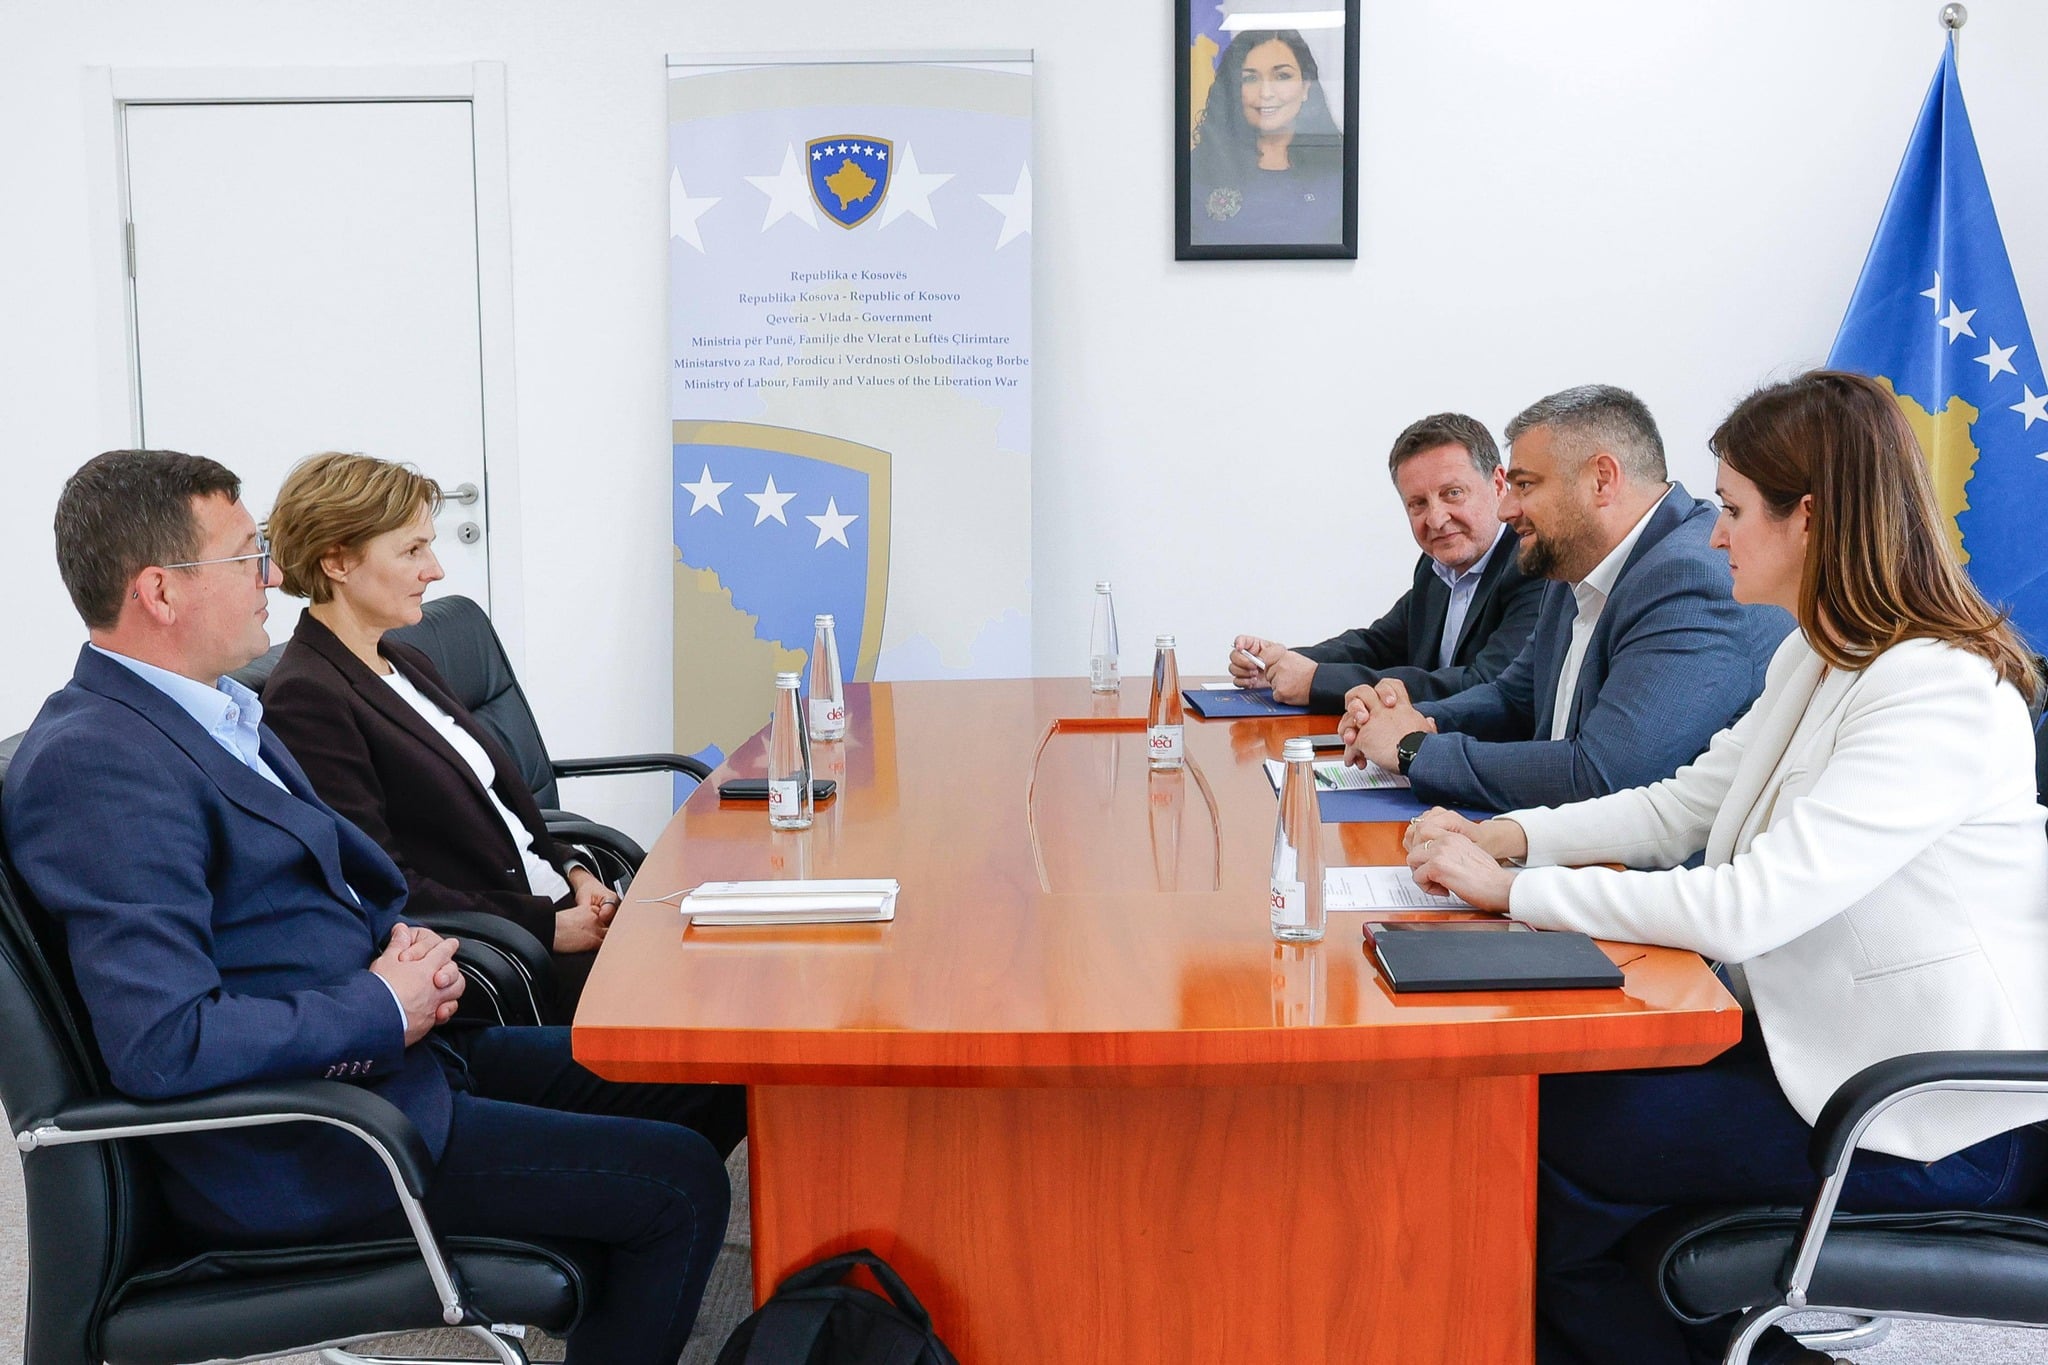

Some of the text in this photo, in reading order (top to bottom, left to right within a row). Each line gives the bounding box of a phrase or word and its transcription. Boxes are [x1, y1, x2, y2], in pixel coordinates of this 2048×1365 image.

[790, 269, 908, 283] Republika e Kosovës
[739, 292, 796, 306] Republika
[799, 291, 840, 303] Kosova
[850, 290, 901, 304] Republic
[903, 290, 916, 301] of
[918, 290, 961, 301] Kosovo
[765, 313, 809, 326] Qeveria
[819, 311, 852, 323] Vlada
[861, 311, 933, 322] Government
[691, 333, 1010, 349] Ministria për Punë, Familje dhe Vlerat e Luftës Çlirimtare
[674, 357, 741, 369] Ministarstvo
[743, 359, 756, 367] za
[759, 355, 784, 368] Rad,
[786, 354, 835, 366] Porodicu
[845, 354, 901, 365] Verdnosti
[904, 354, 994, 368] Oslobodilačkog
[996, 355, 1030, 366] Borbe
[684, 375, 1019, 392] Ministry of Labour, Family and Values of the Liberation War
